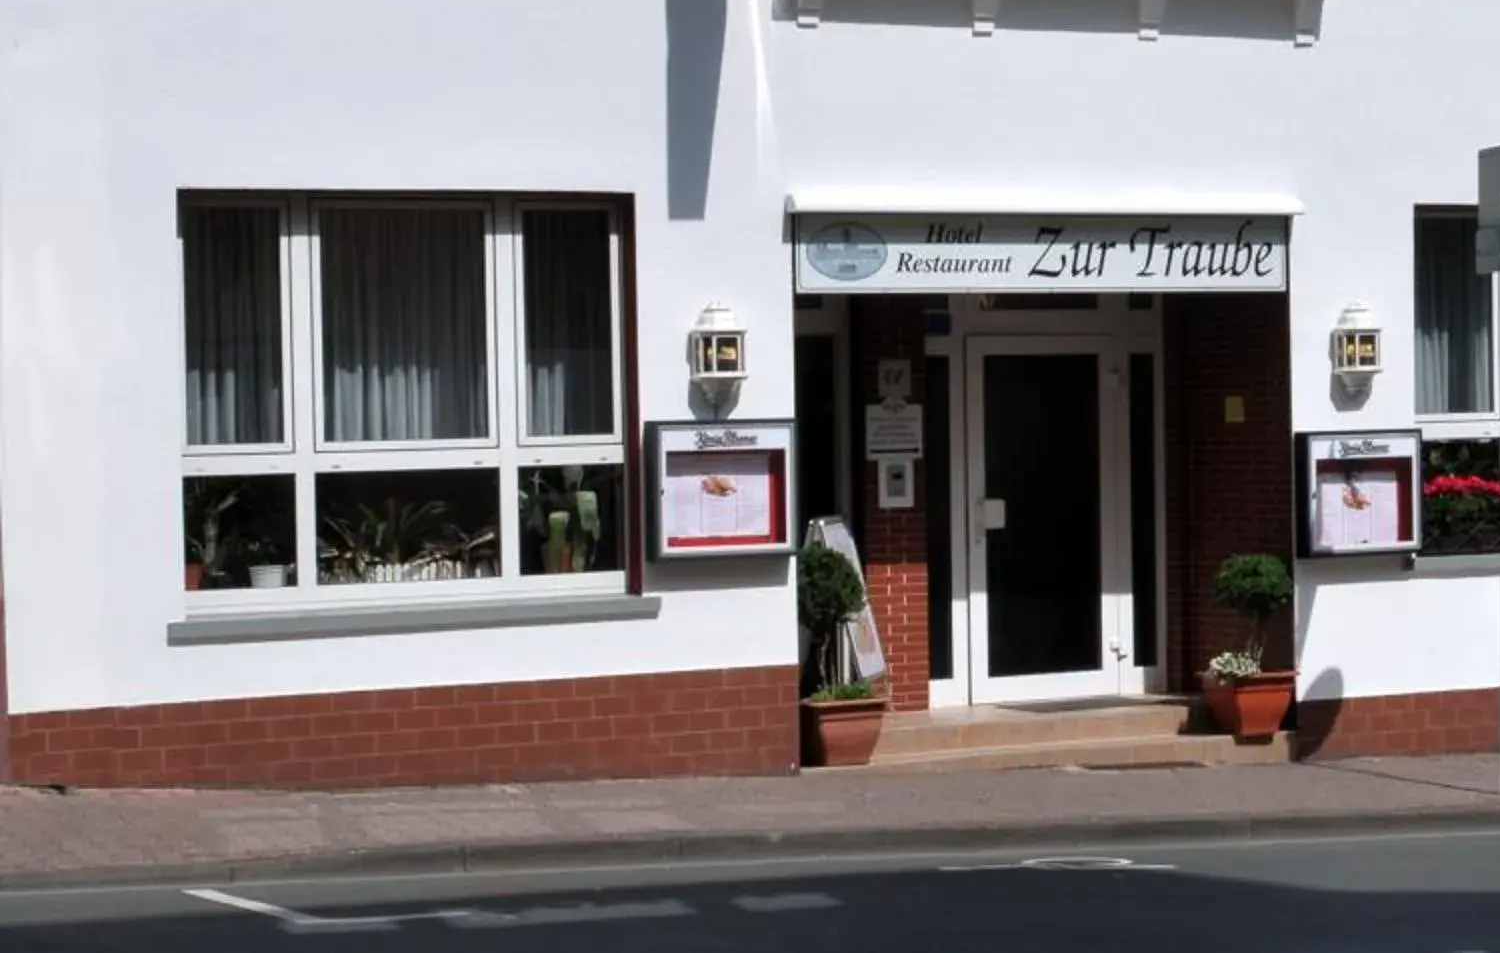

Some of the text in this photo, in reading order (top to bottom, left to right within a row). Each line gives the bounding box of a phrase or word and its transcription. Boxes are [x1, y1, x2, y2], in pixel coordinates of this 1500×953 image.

[924, 221, 984, 245] Hotel
[1027, 219, 1275, 279] Zur Traube
[896, 251, 1013, 274] Restaurant
